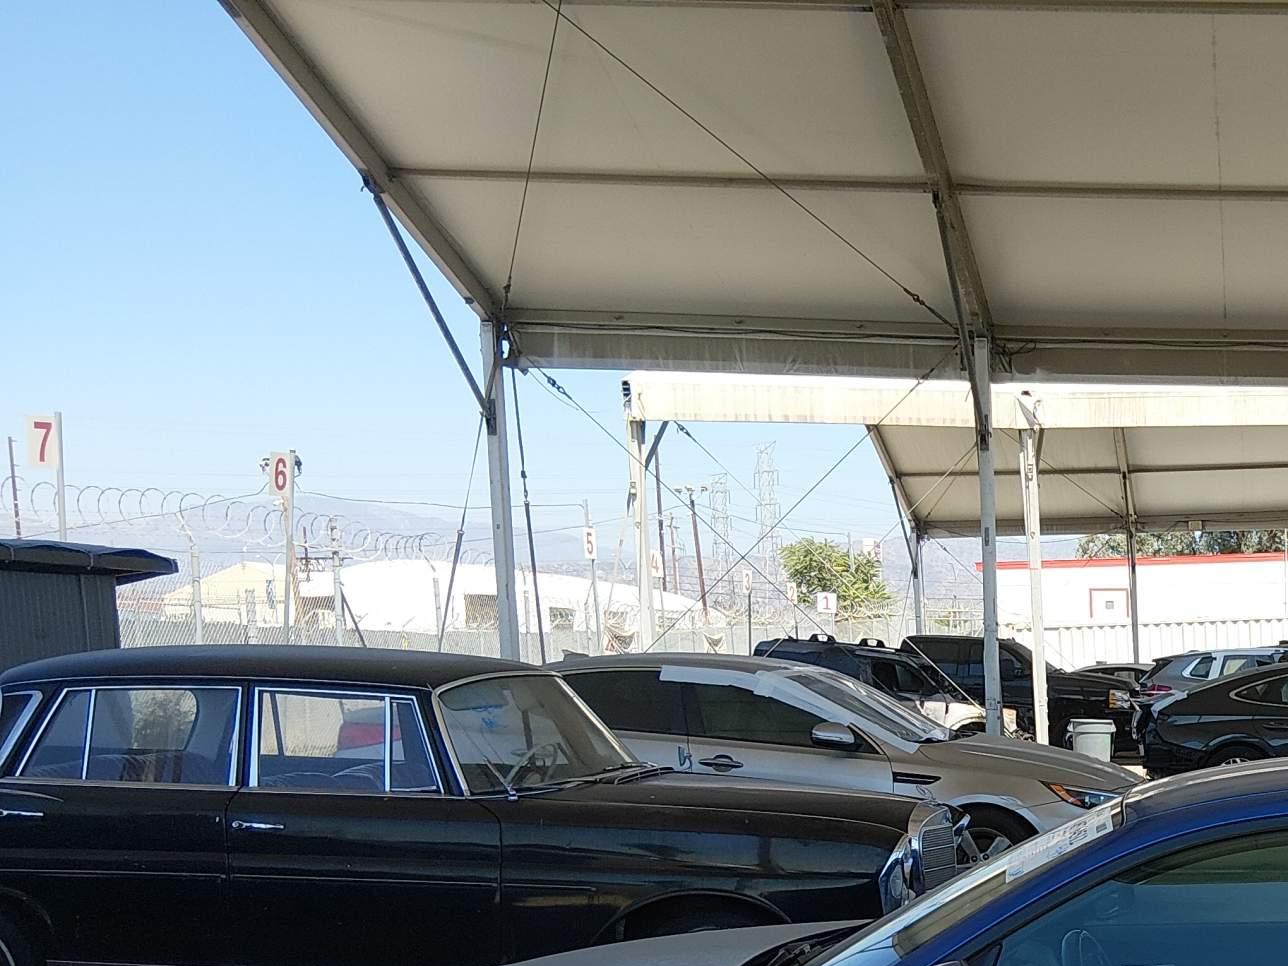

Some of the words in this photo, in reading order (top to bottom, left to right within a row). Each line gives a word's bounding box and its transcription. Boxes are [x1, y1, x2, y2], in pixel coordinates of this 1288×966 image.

[33, 421, 52, 463] 7
[275, 457, 287, 491] 6
[586, 532, 594, 555] 5
[651, 553, 660, 573] 4
[744, 572, 751, 591] 3
[822, 595, 831, 610] 1
